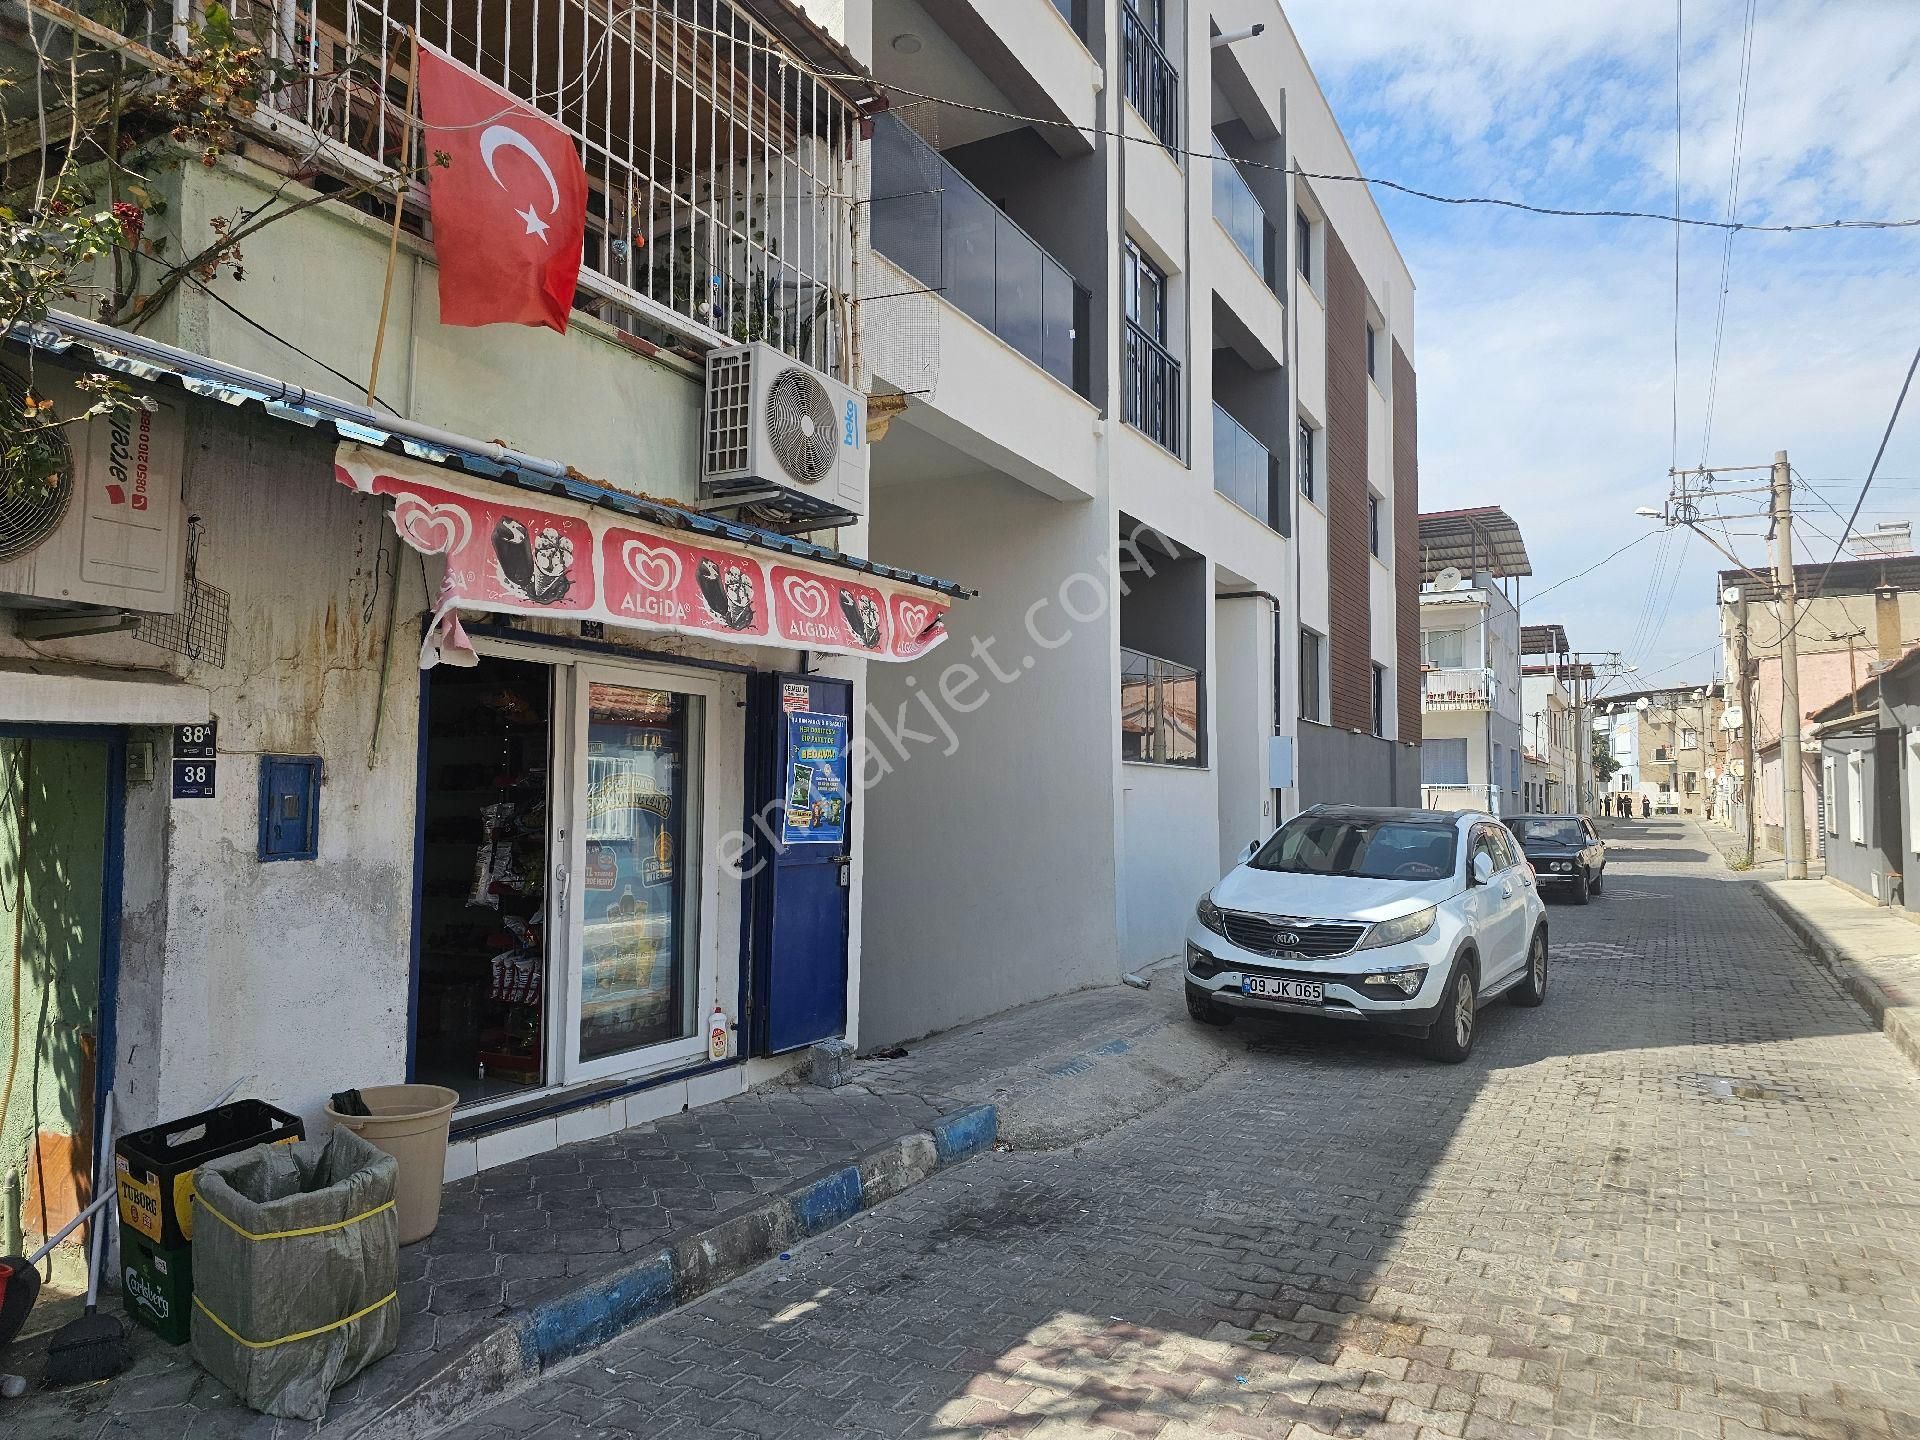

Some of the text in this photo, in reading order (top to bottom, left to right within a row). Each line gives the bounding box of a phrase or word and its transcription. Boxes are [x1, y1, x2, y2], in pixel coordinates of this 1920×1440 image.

[843, 399, 854, 446] beko
[137, 443, 149, 463] 210
[135, 463, 148, 493] 0850
[184, 766, 206, 783] 38
[1276, 934, 1296, 944] KIA
[1295, 983, 1321, 999] 065
[121, 1181, 157, 1217] TUBORG
[126, 1266, 169, 1318] Carlsberg
